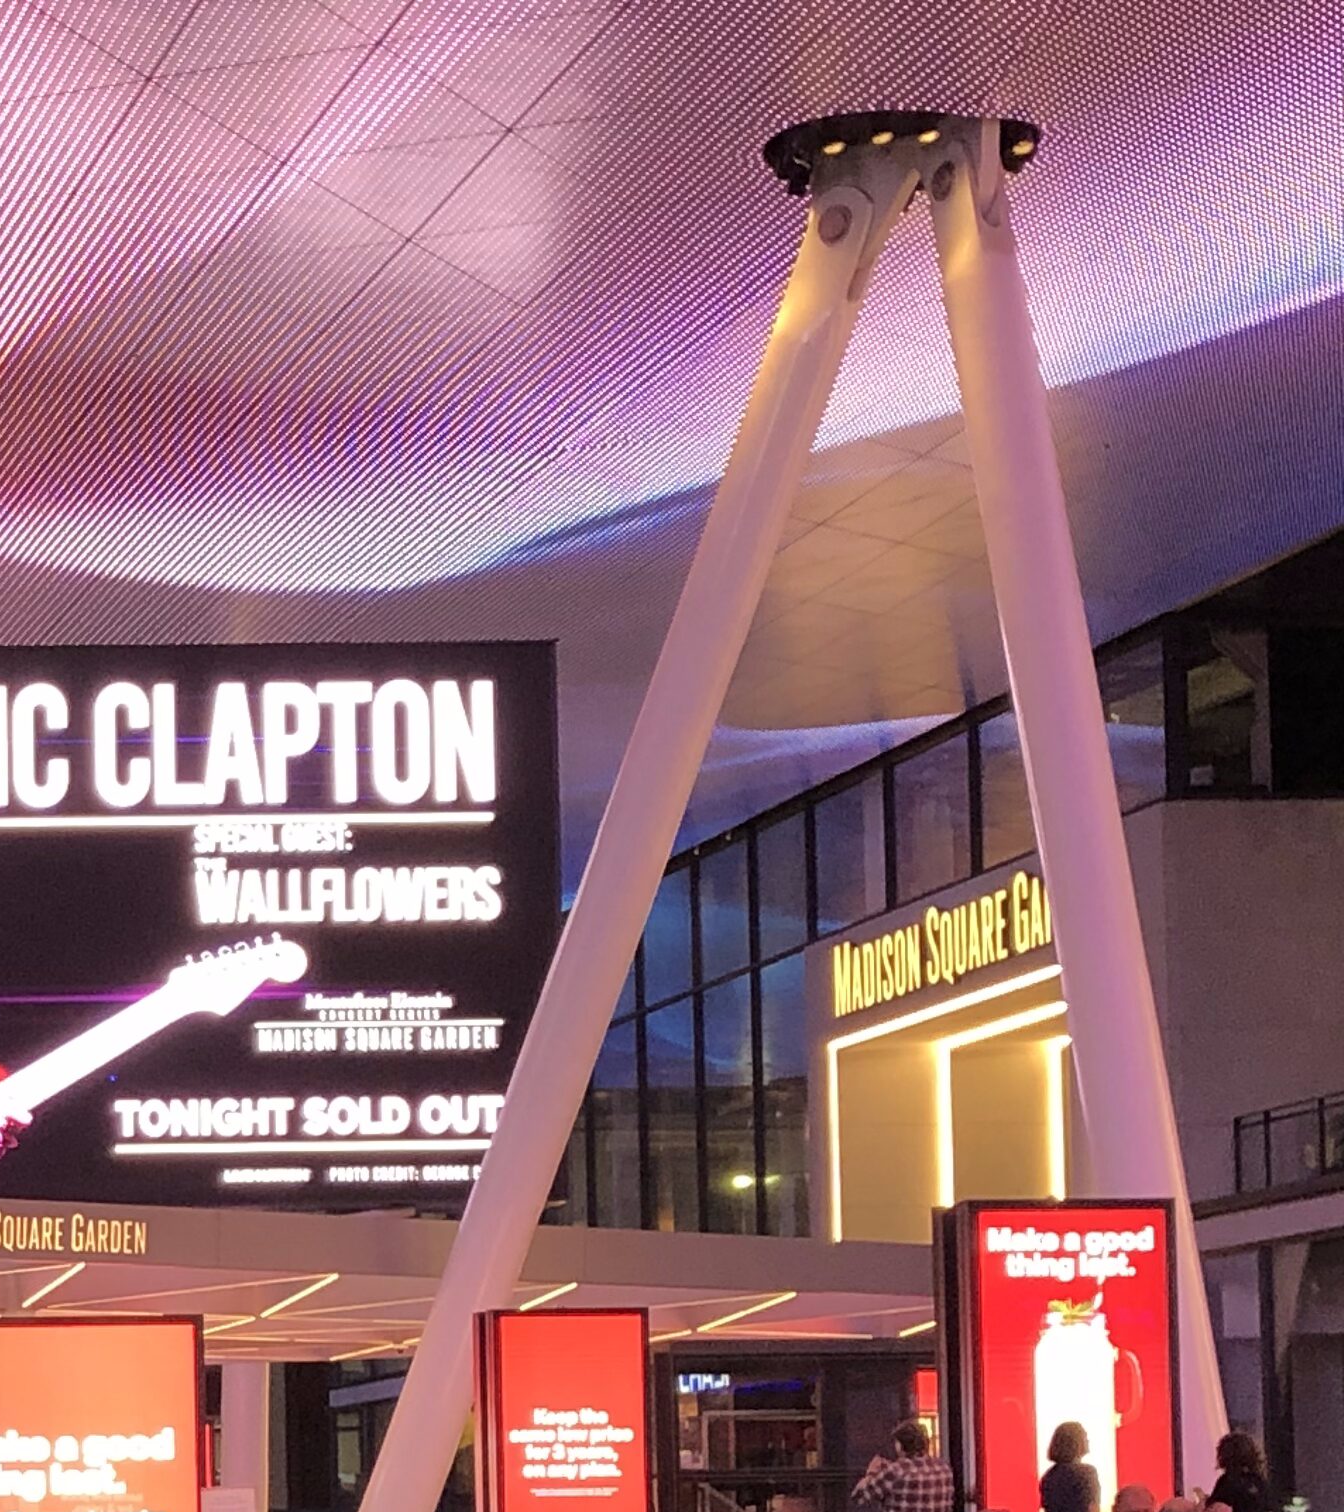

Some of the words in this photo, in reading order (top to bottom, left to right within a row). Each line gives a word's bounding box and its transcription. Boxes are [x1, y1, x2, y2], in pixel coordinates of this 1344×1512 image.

[92, 679, 497, 807] CLAPTON
[195, 865, 502, 924] WALLFLOWERS
[832, 923, 921, 1019] MADISON
[925, 889, 1009, 985] SQUARE
[258, 1028, 338, 1052] MADISON
[344, 1026, 414, 1052] SQUARE
[114, 1097, 294, 1138] TONIGHT
[303, 1095, 410, 1137] SOLD
[69, 1213, 148, 1255] GARDEN
[986, 1226, 1060, 1252] Make
[1084, 1225, 1155, 1256] good
[1005, 1251, 1075, 1282] thing
[81, 1426, 175, 1468] good
